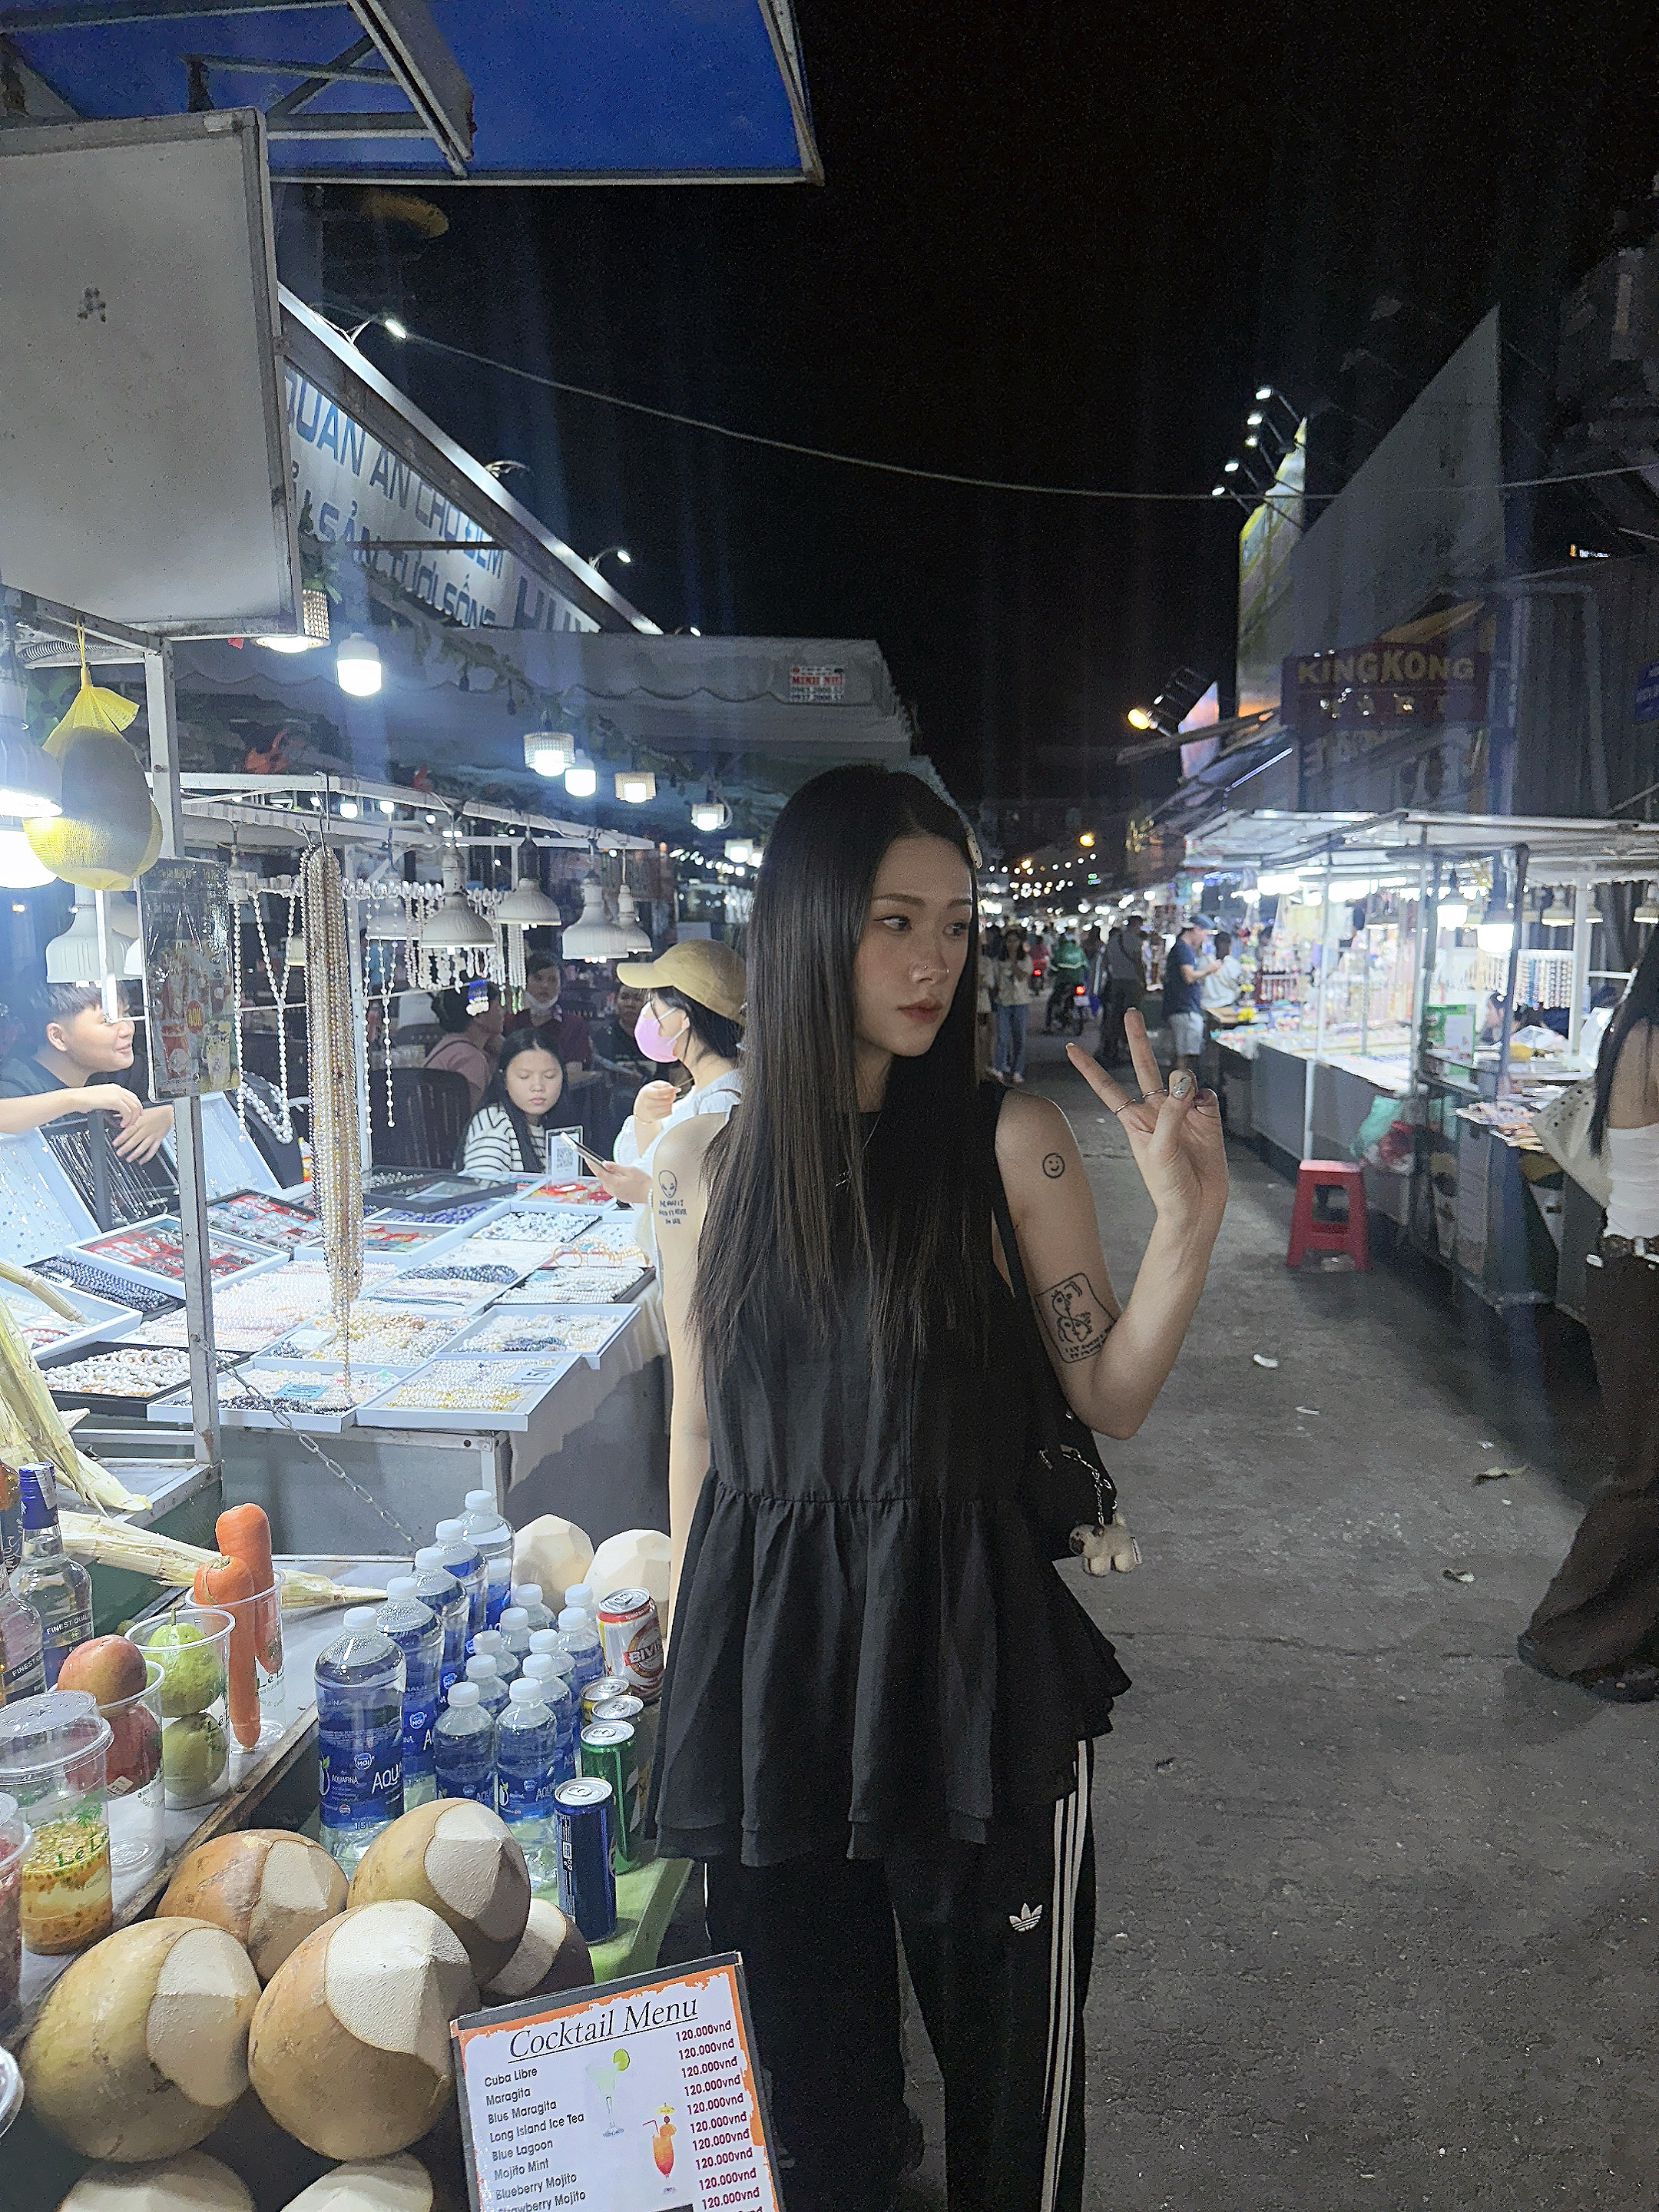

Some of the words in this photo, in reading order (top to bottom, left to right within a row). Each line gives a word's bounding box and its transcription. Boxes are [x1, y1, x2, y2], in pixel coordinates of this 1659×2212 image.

[46, 1621, 72, 1634] FINEST
[12, 1659, 35, 1677] FINEST
[510, 2009, 615, 2058] Cocktail
[624, 1998, 698, 2033] Menu
[676, 2020, 732, 2042] 120.000vnđ
[678, 2038, 735, 2060] 120.000vnđ
[485, 2074, 512, 2087] Cuba
[515, 2068, 538, 2081] Libre
[682, 2056, 738, 2078] 120.000vnđ
[486, 2088, 531, 2106] Maragita
[684, 2074, 741, 2097] 120.000vnđ
[488, 2112, 509, 2124] Blue
[512, 2101, 557, 2119] Maragita
[687, 2092, 744, 2115] 120.000vnđ
[490, 2130, 514, 2143] Long
[517, 2120, 546, 2137] Island
[549, 2118, 565, 2129] Ice
[567, 2113, 584, 2125] Tea
[693, 2128, 750, 2151] 120.000vnđ
[492, 2149, 513, 2161] Blue
[516, 2139, 553, 2156] Lagoon
[696, 2147, 753, 2170] 120.000vnđ
[494, 2165, 525, 2181] Mojito
[528, 2157, 549, 2173] Mint
[699, 2167, 757, 2190] 120.000vnđ
[495, 2181, 543, 2200] Blueberry
[546, 2173, 578, 2189] Mojito
[702, 2186, 760, 2210] 120.000vnđ
[555, 2190, 586, 2207] Mojito
